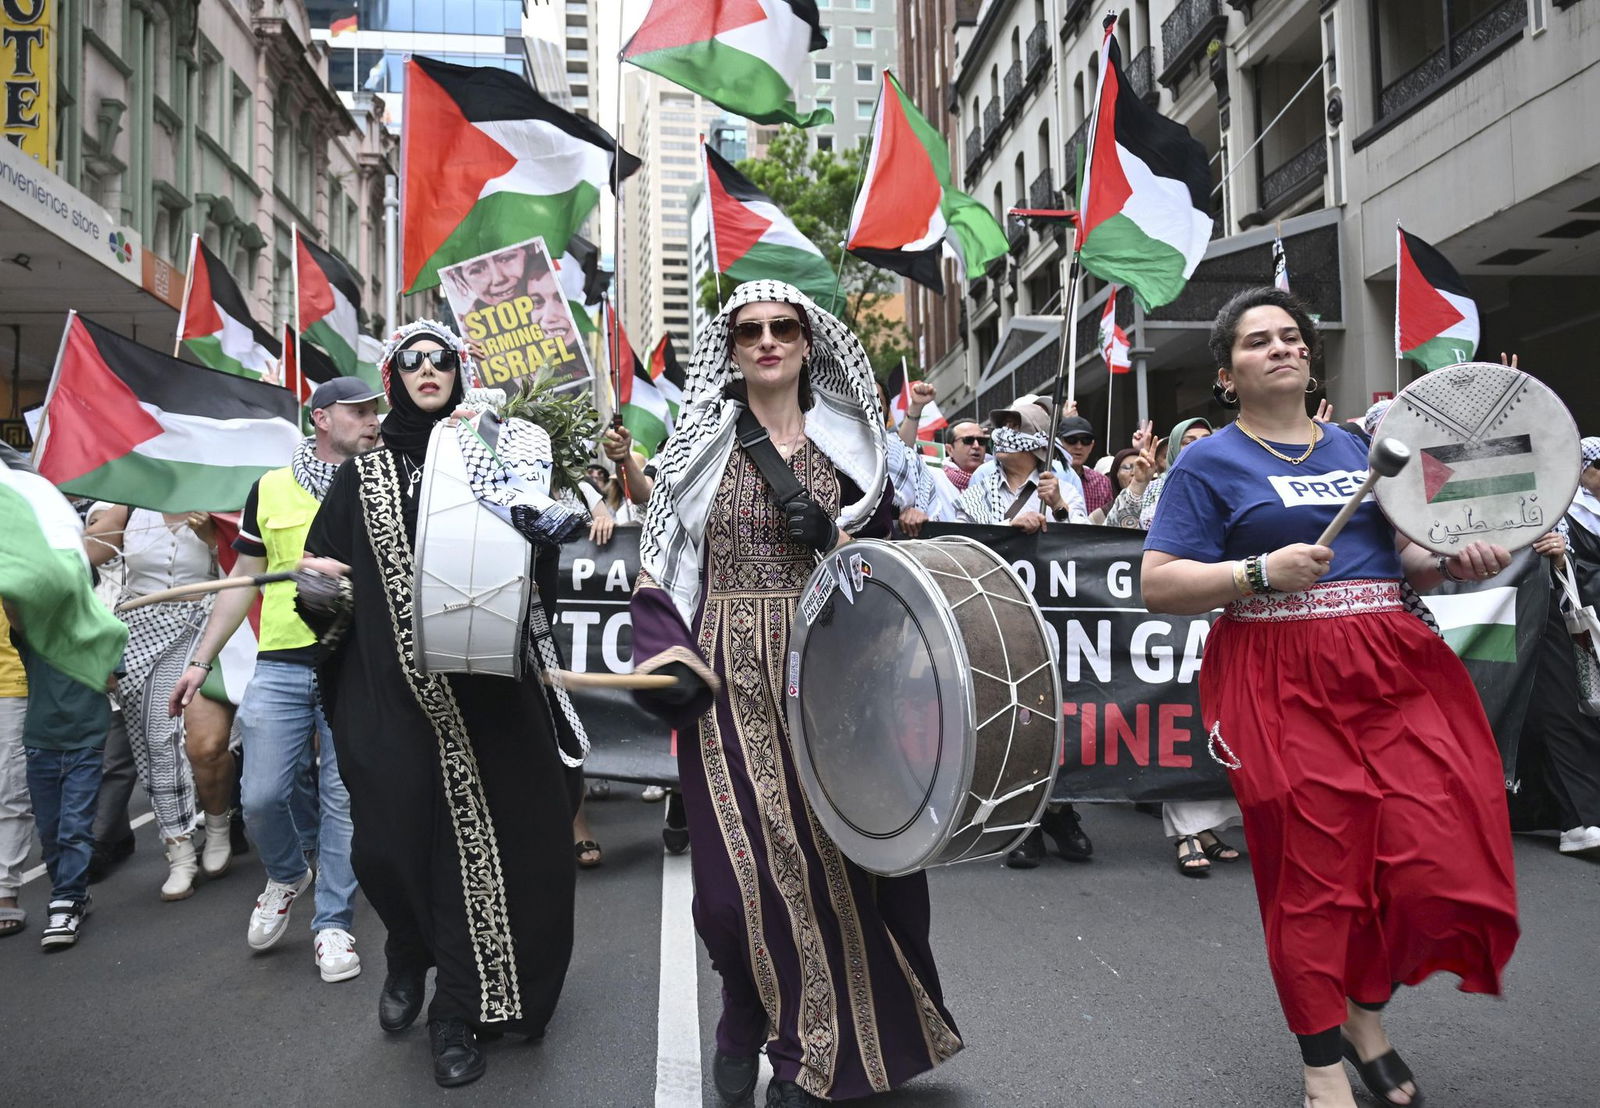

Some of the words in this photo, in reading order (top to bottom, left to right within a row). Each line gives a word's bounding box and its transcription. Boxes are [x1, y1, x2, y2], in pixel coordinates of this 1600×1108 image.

[1, 0, 44, 150] OTE
[0, 161, 69, 219] nvenience
[72, 209, 100, 240] store
[465, 296, 534, 340] STOP
[480, 336, 577, 386] ISRAEL
[1288, 475, 1370, 498] PRE
[1428, 493, 1543, 544] فلسطين
[572, 558, 631, 592] PA
[1011, 560, 1077, 598] ON
[1107, 561, 1132, 598] G
[803, 591, 818, 614] FREE
[553, 611, 633, 674] TO
[1130, 620, 1209, 683] GA
